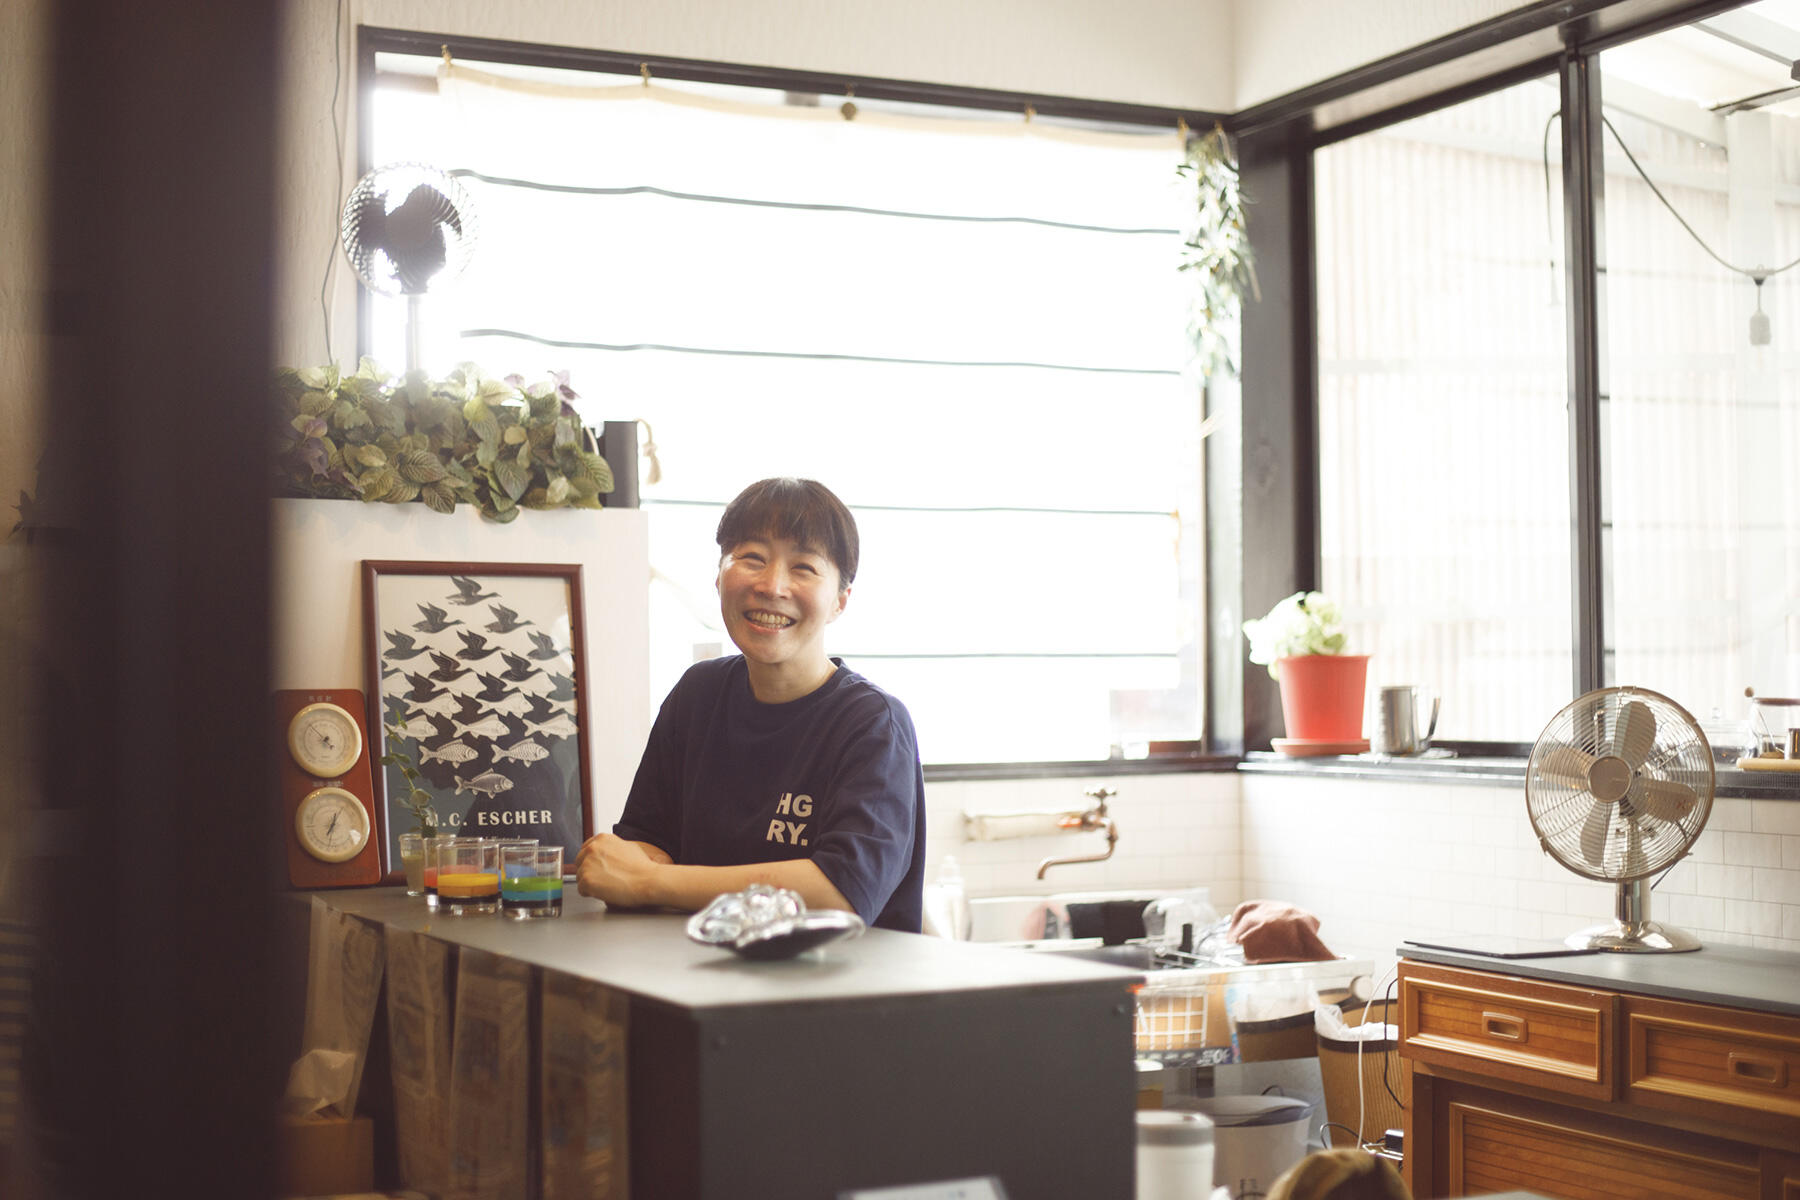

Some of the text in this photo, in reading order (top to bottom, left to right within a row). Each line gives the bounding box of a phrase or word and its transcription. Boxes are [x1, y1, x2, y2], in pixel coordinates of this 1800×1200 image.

[477, 809, 553, 826] ESCHER
[775, 792, 814, 818] HG
[766, 818, 809, 847] RY.
